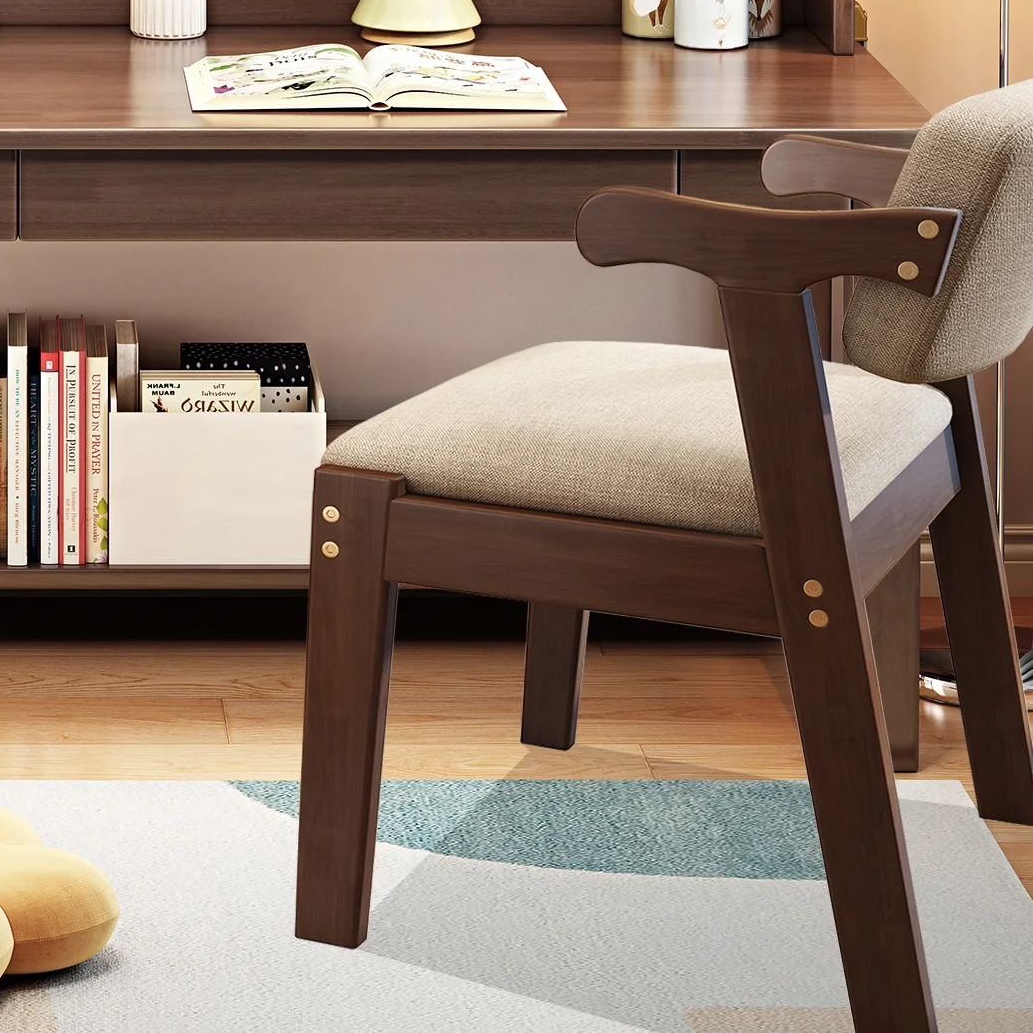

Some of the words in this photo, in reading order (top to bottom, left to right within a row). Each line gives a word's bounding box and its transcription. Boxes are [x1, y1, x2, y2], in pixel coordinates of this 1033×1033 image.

[66, 379, 76, 419] PURSUIT
[92, 374, 101, 419] UNITED
[69, 423, 76, 435] OF
[92, 422, 99, 432] IN
[66, 439, 76, 473] PROFIT
[92, 434, 101, 475] PRAYER
[93, 505, 99, 513] E.
